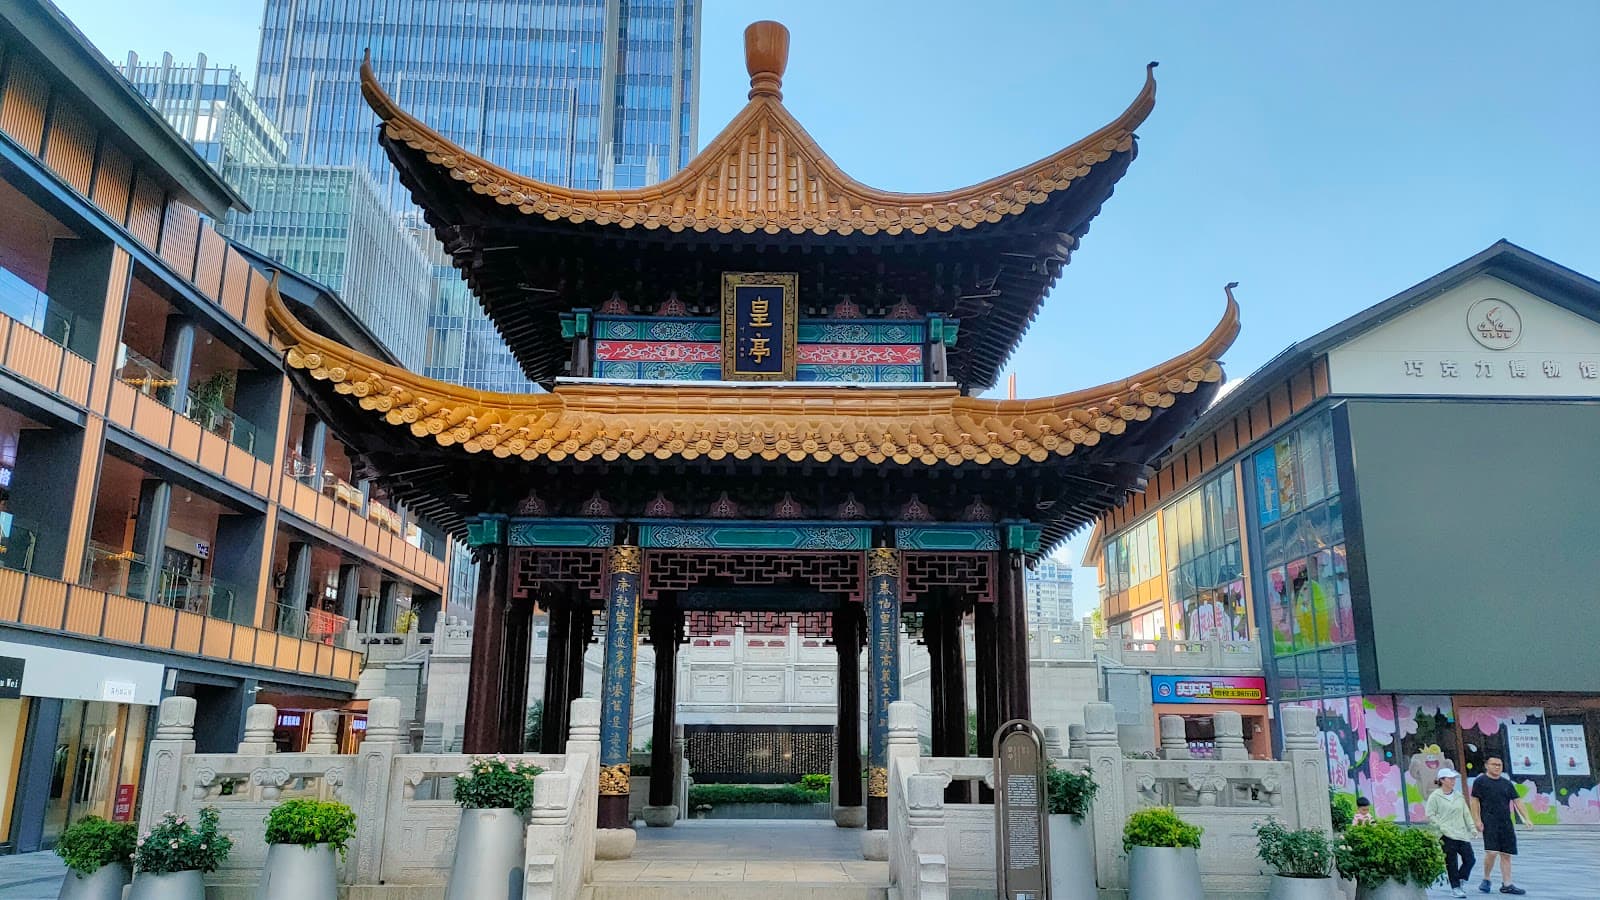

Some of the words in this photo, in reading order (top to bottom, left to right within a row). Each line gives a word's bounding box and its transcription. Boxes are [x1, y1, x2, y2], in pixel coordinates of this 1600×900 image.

[749, 295, 773, 364] 皇亭
[1403, 359, 1600, 379] 巧克力博物馆
